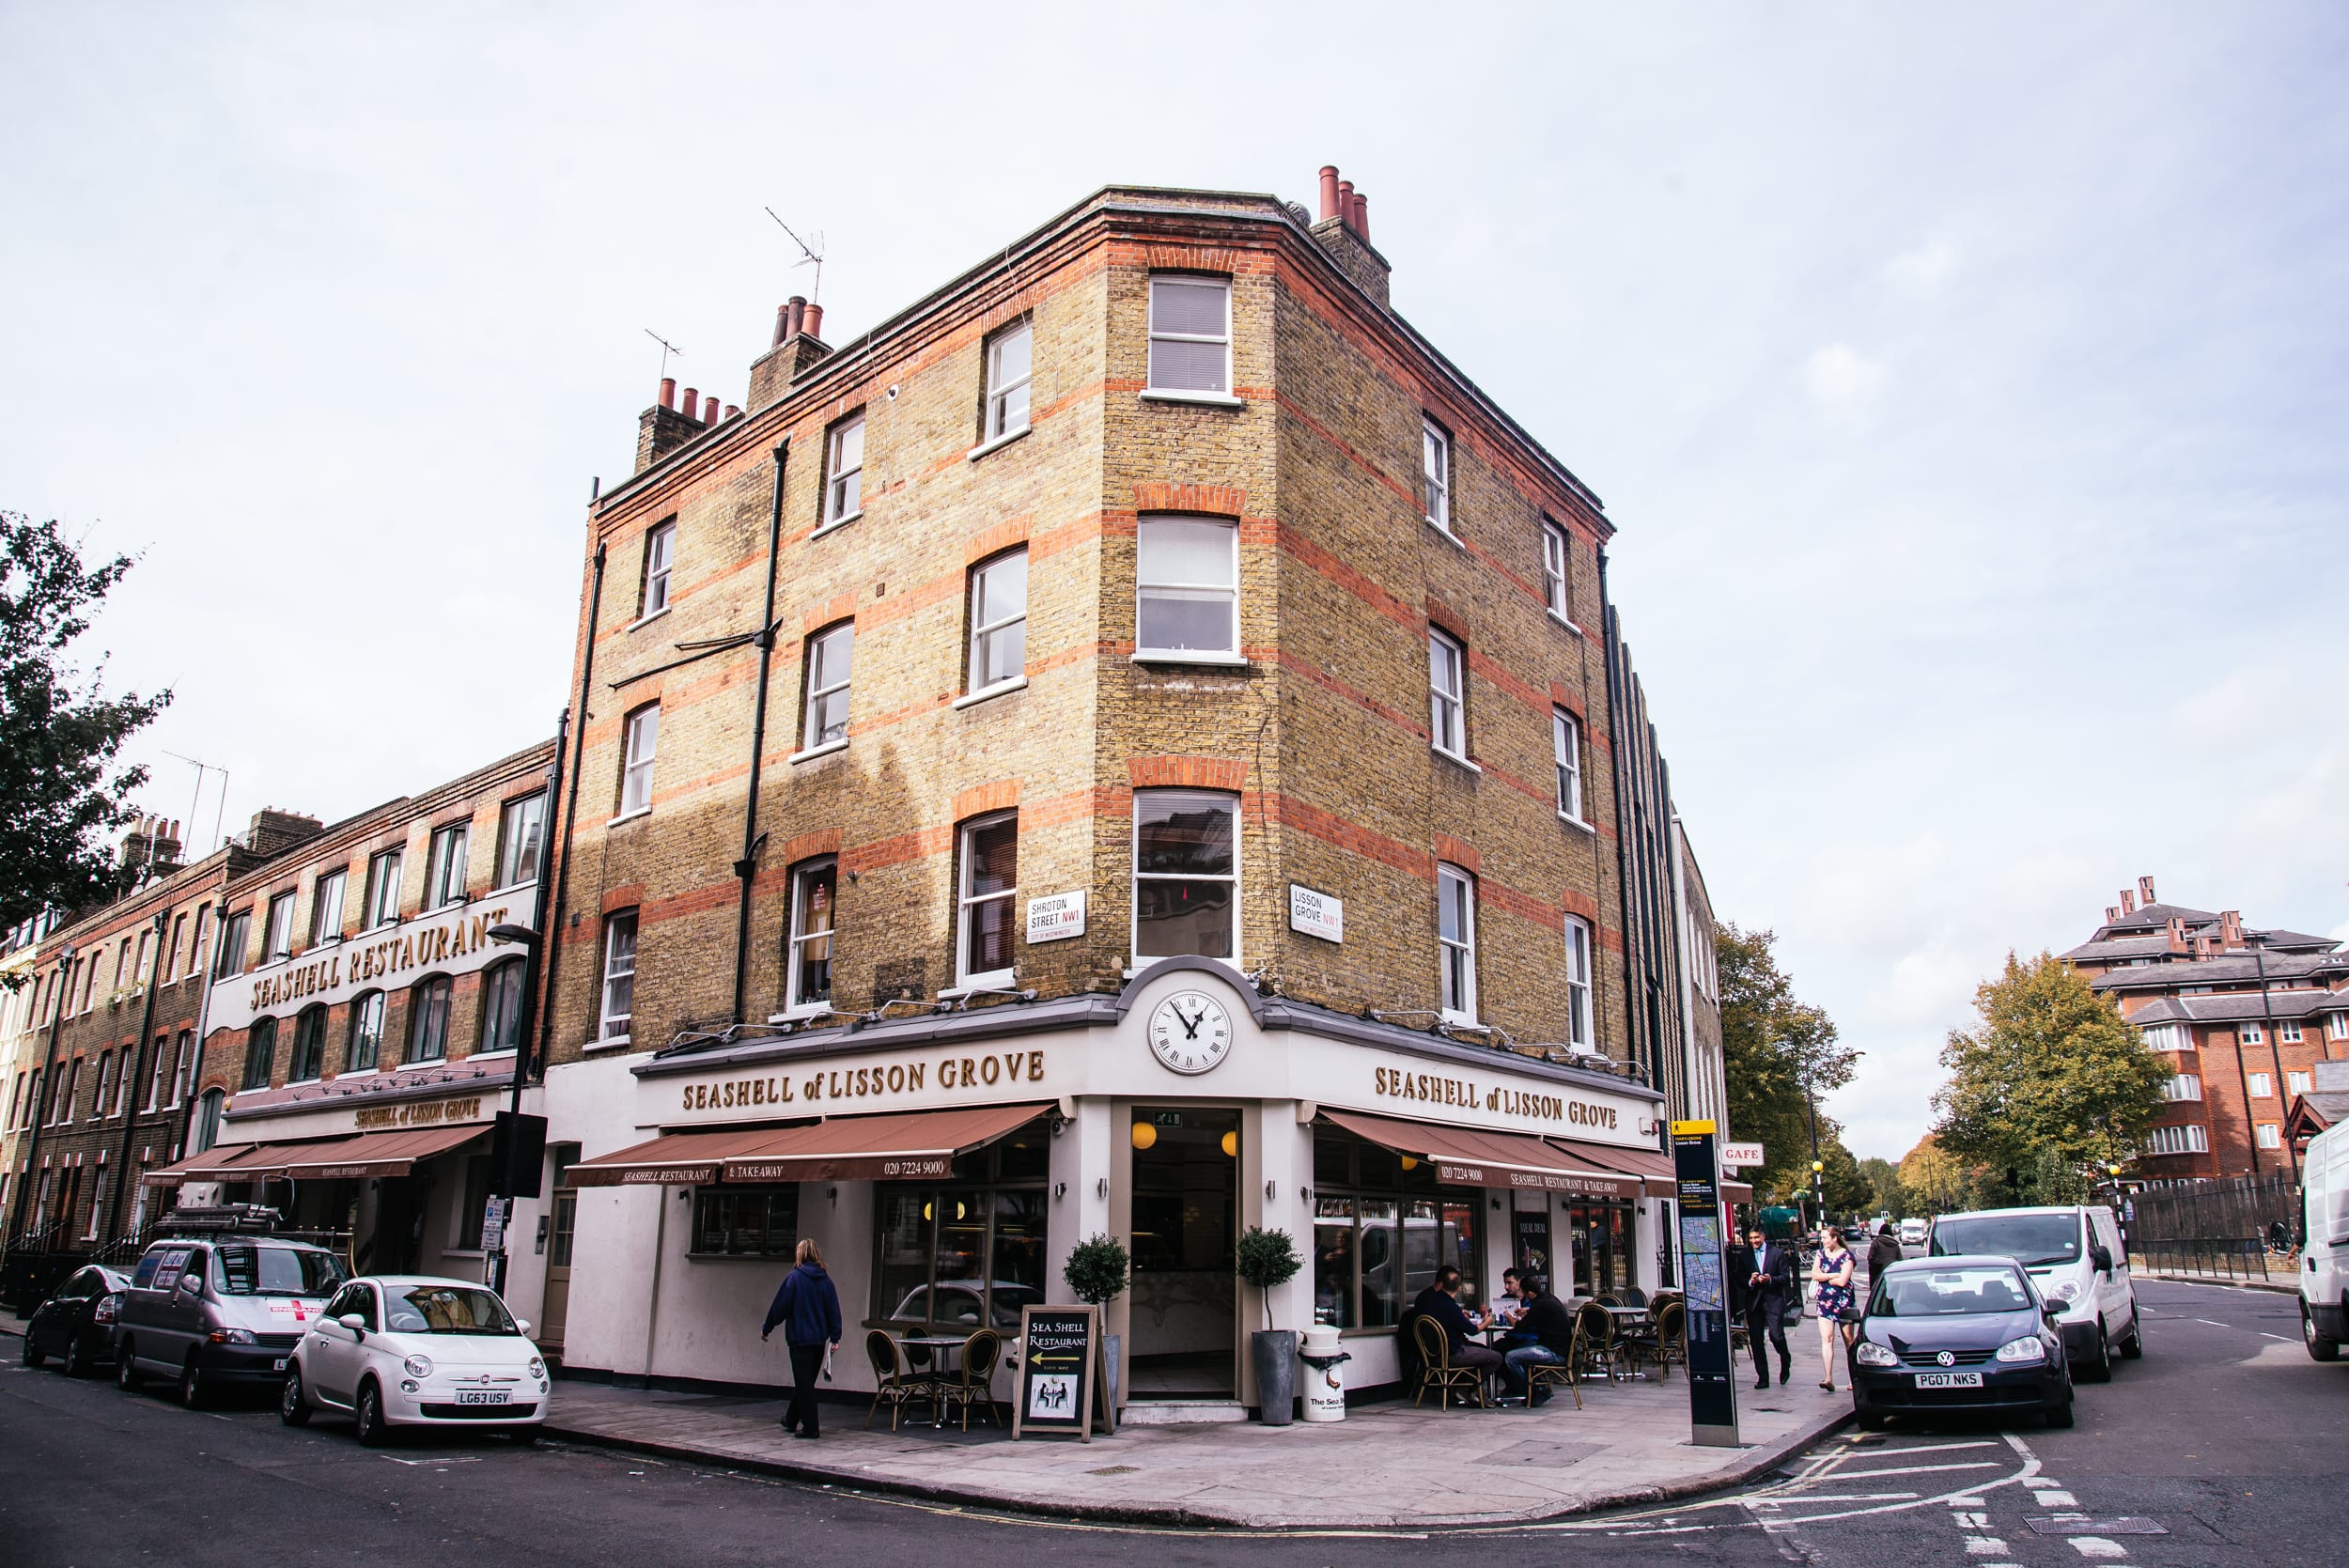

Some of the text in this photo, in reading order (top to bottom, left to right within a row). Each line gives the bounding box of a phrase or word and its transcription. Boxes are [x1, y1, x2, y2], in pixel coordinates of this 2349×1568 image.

[1032, 898, 1067, 915] SHROTON
[1295, 891, 1322, 909] LISSON
[1032, 909, 1080, 928] STREET NW1
[1295, 905, 1339, 927] GROVE NW1
[250, 907, 508, 1010] SEASHELL RESTAURANT
[683, 1050, 1045, 1110] SEASHELL of LISSON GROVE
[1375, 1066, 1618, 1128] SEASHELL of LISSON GROVE
[354, 1097, 481, 1126] SEASHELL of LISSON GROVE
[622, 1169, 711, 1182] SEASHELL RESTAURANT
[738, 1165, 784, 1178] TAKEAWAY
[884, 1160, 944, 1174] 020 7224 9000
[1441, 1166, 1483, 1182] 020 7224 9000
[1511, 1173, 1544, 1187] SEASHELL
[1545, 1176, 1582, 1190] RESTAURANT
[1589, 1181, 1618, 1193] TAKEAWAY
[1032, 1322, 1085, 1332] SEA SHELL
[1029, 1335, 1087, 1348] RESTAURANT
[1921, 1374, 1977, 1386] PG07 NKS
[459, 1392, 509, 1404] LG63 USV
